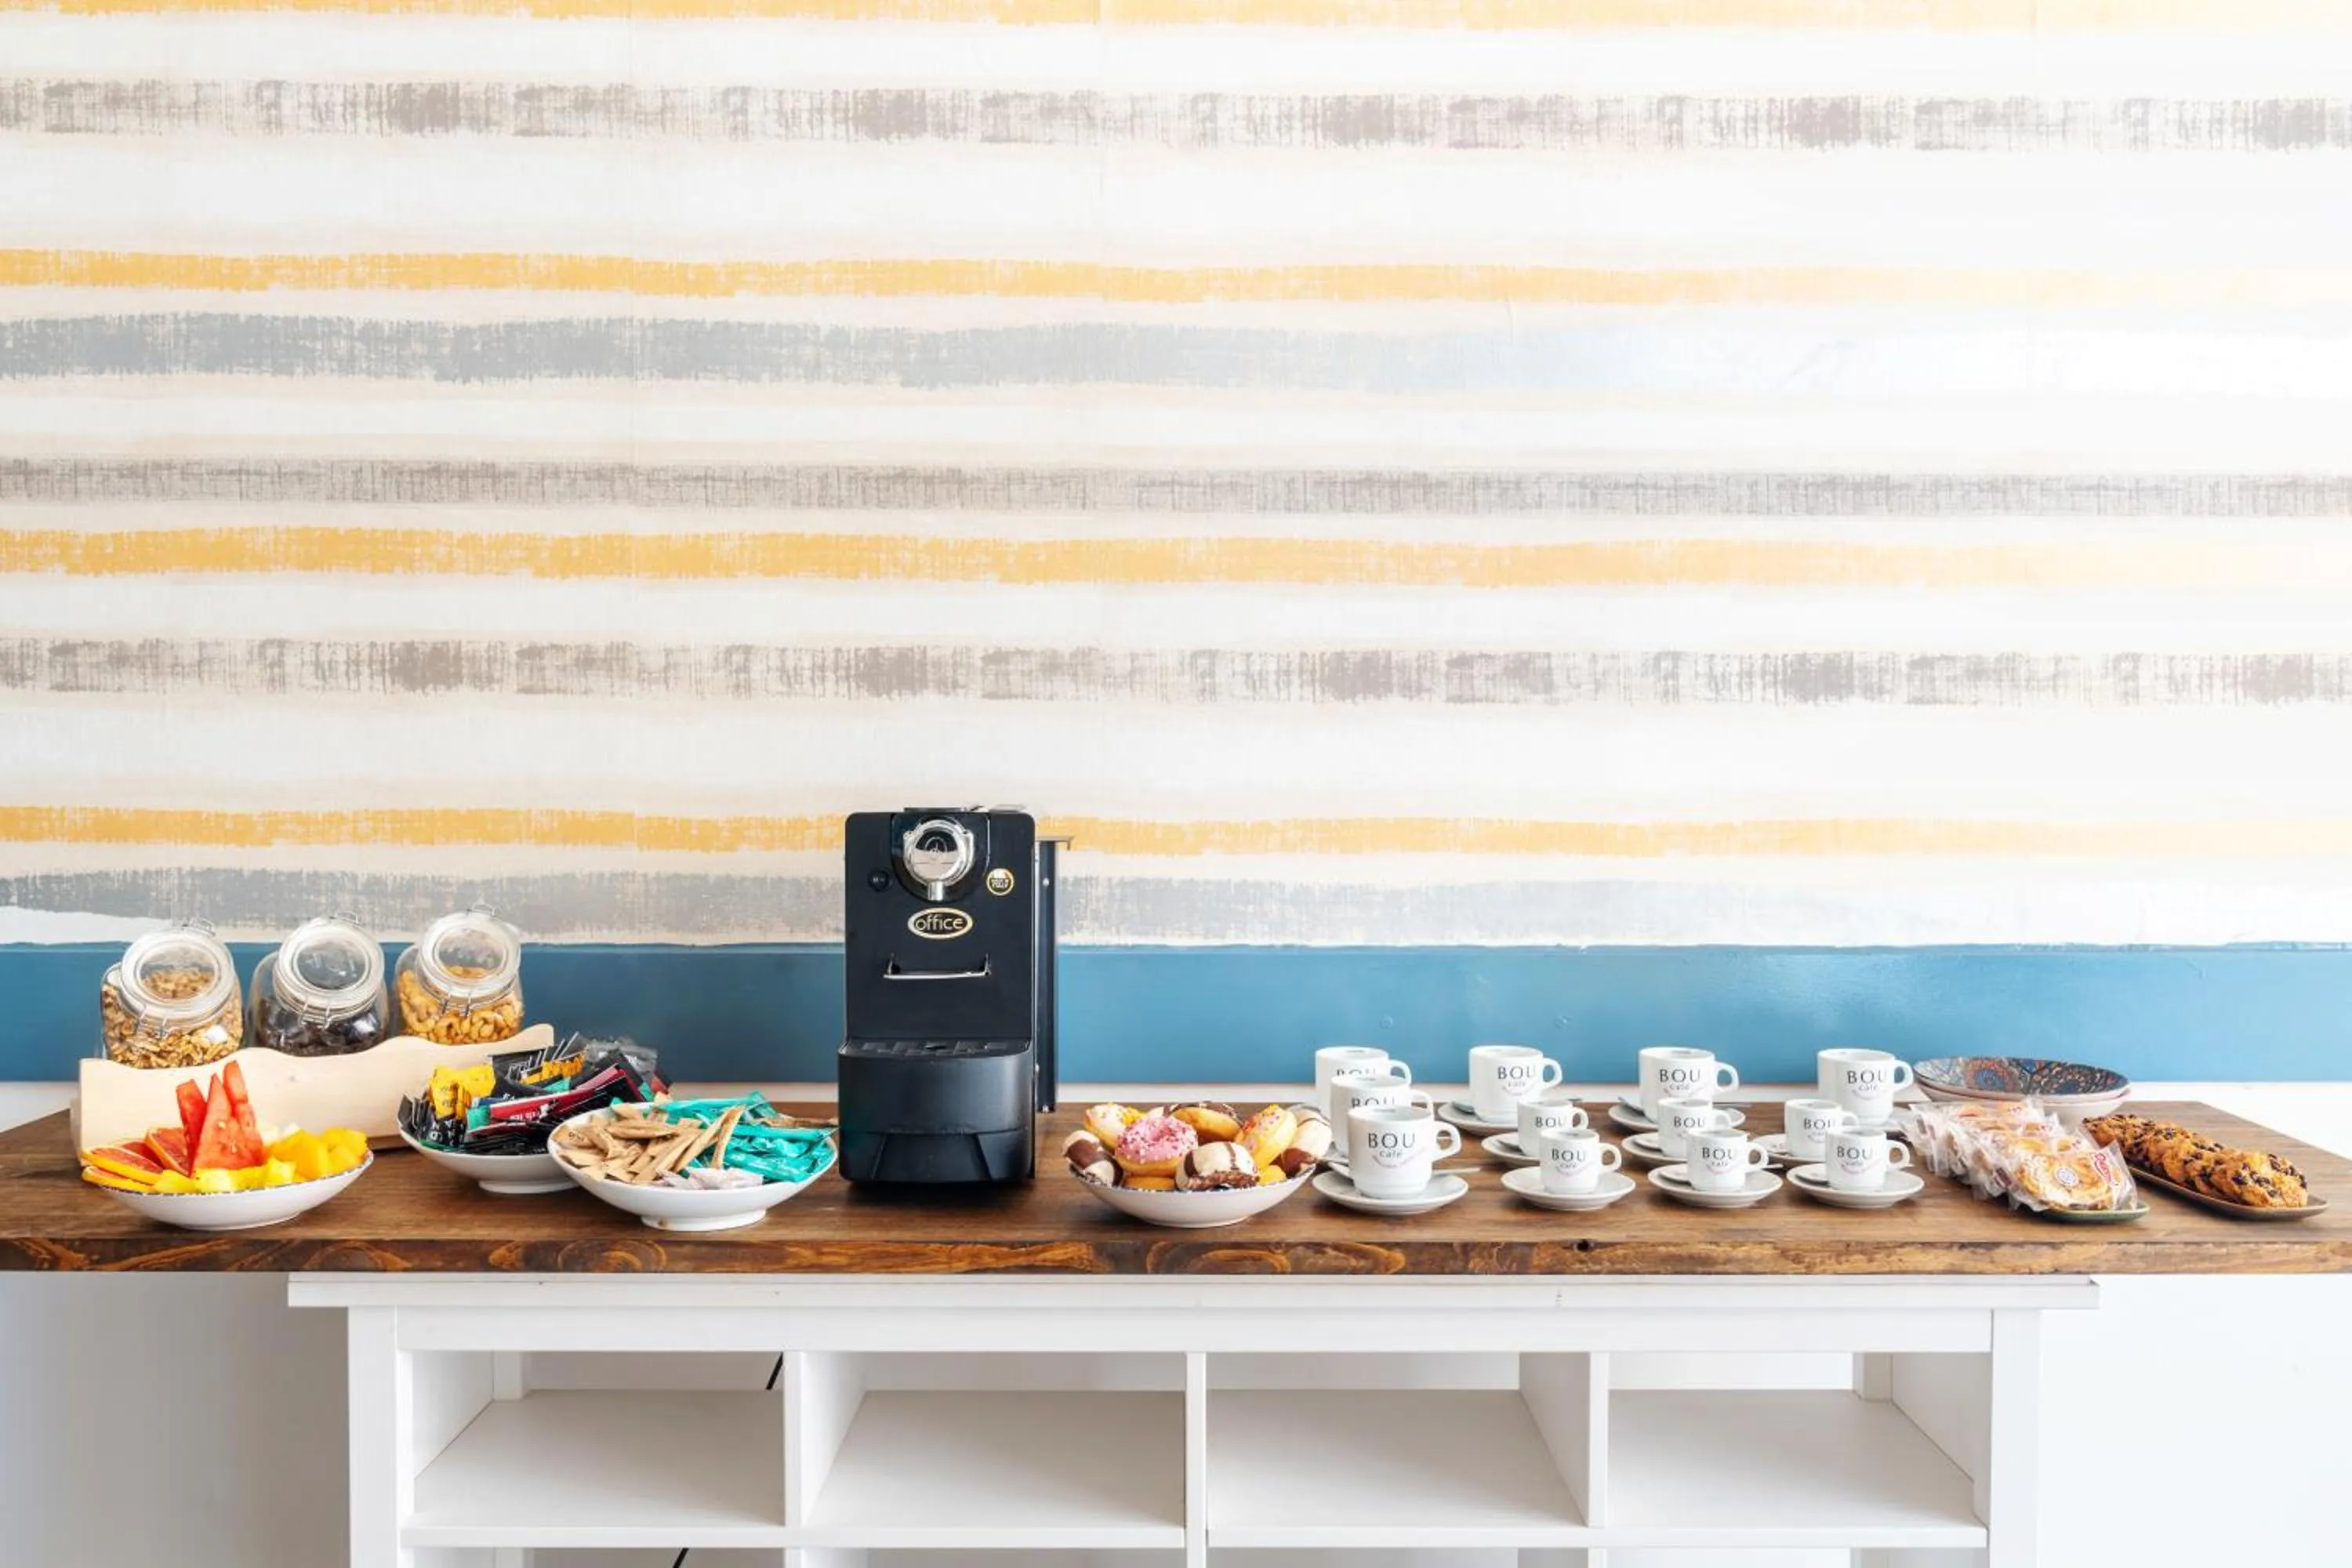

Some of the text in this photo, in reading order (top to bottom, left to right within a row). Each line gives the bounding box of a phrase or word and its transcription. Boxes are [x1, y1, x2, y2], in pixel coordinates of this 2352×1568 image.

[915, 913, 964, 931] office
[1497, 1066, 1536, 1080] BOU
[1660, 1069, 1700, 1083] BOU
[1847, 1069, 1887, 1083] BOU
[1534, 1116, 1566, 1128] BOU
[1674, 1116, 1705, 1128] BOU
[1804, 1118, 1836, 1130] BOU
[1367, 1133, 1415, 1149] BOU
[1552, 1148, 1586, 1162] BOU
[1702, 1147, 1736, 1161] BOU
[1837, 1145, 1873, 1160] BOU
